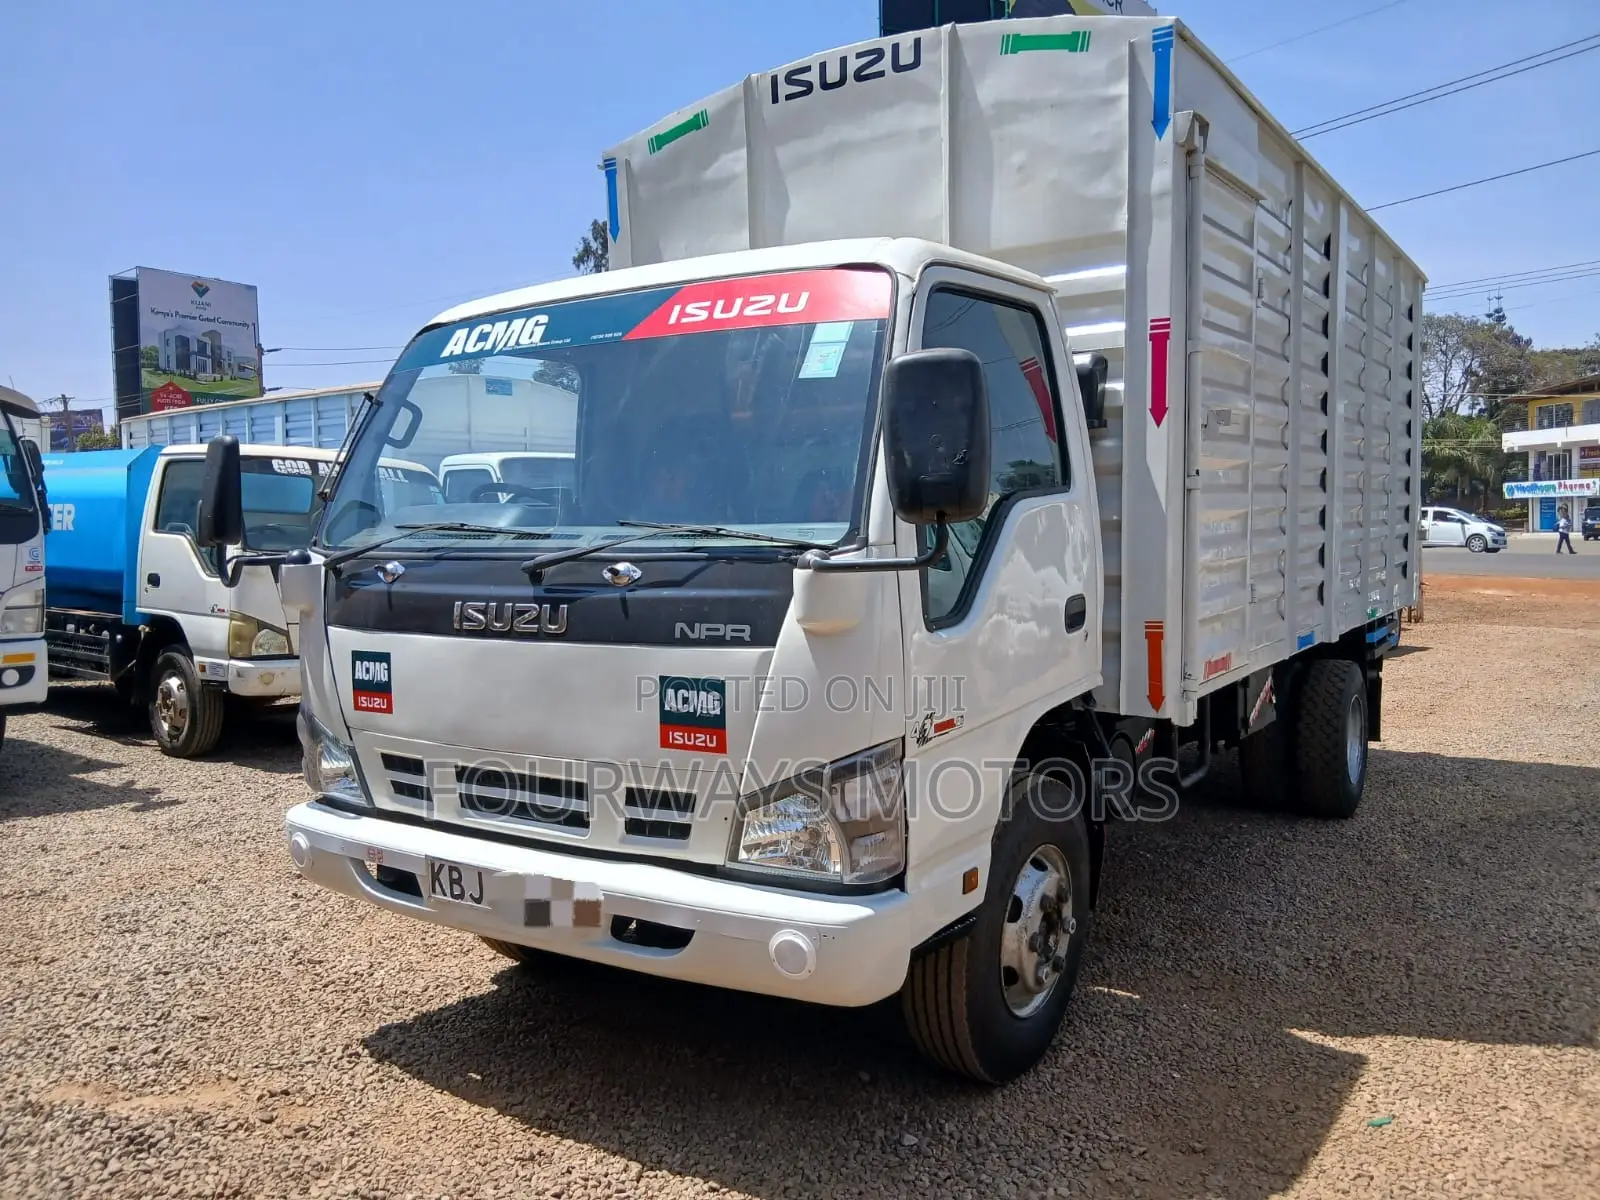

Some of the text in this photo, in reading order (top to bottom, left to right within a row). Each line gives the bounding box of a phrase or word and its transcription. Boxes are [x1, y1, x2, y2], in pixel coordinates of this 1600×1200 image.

[771, 37, 922, 104] ISUZU
[668, 291, 810, 325] ISUZU
[216, 317, 250, 330] Community
[440, 314, 549, 358] ACMG
[1557, 481, 1591, 491] Pharma
[453, 601, 568, 634] ISUZU
[674, 622, 752, 643] NPR
[354, 660, 389, 684] ACMG
[358, 695, 387, 709] ISUZU
[664, 688, 721, 717] ACMG
[669, 731, 717, 747] ISUZU
[430, 861, 484, 905] KBJ
